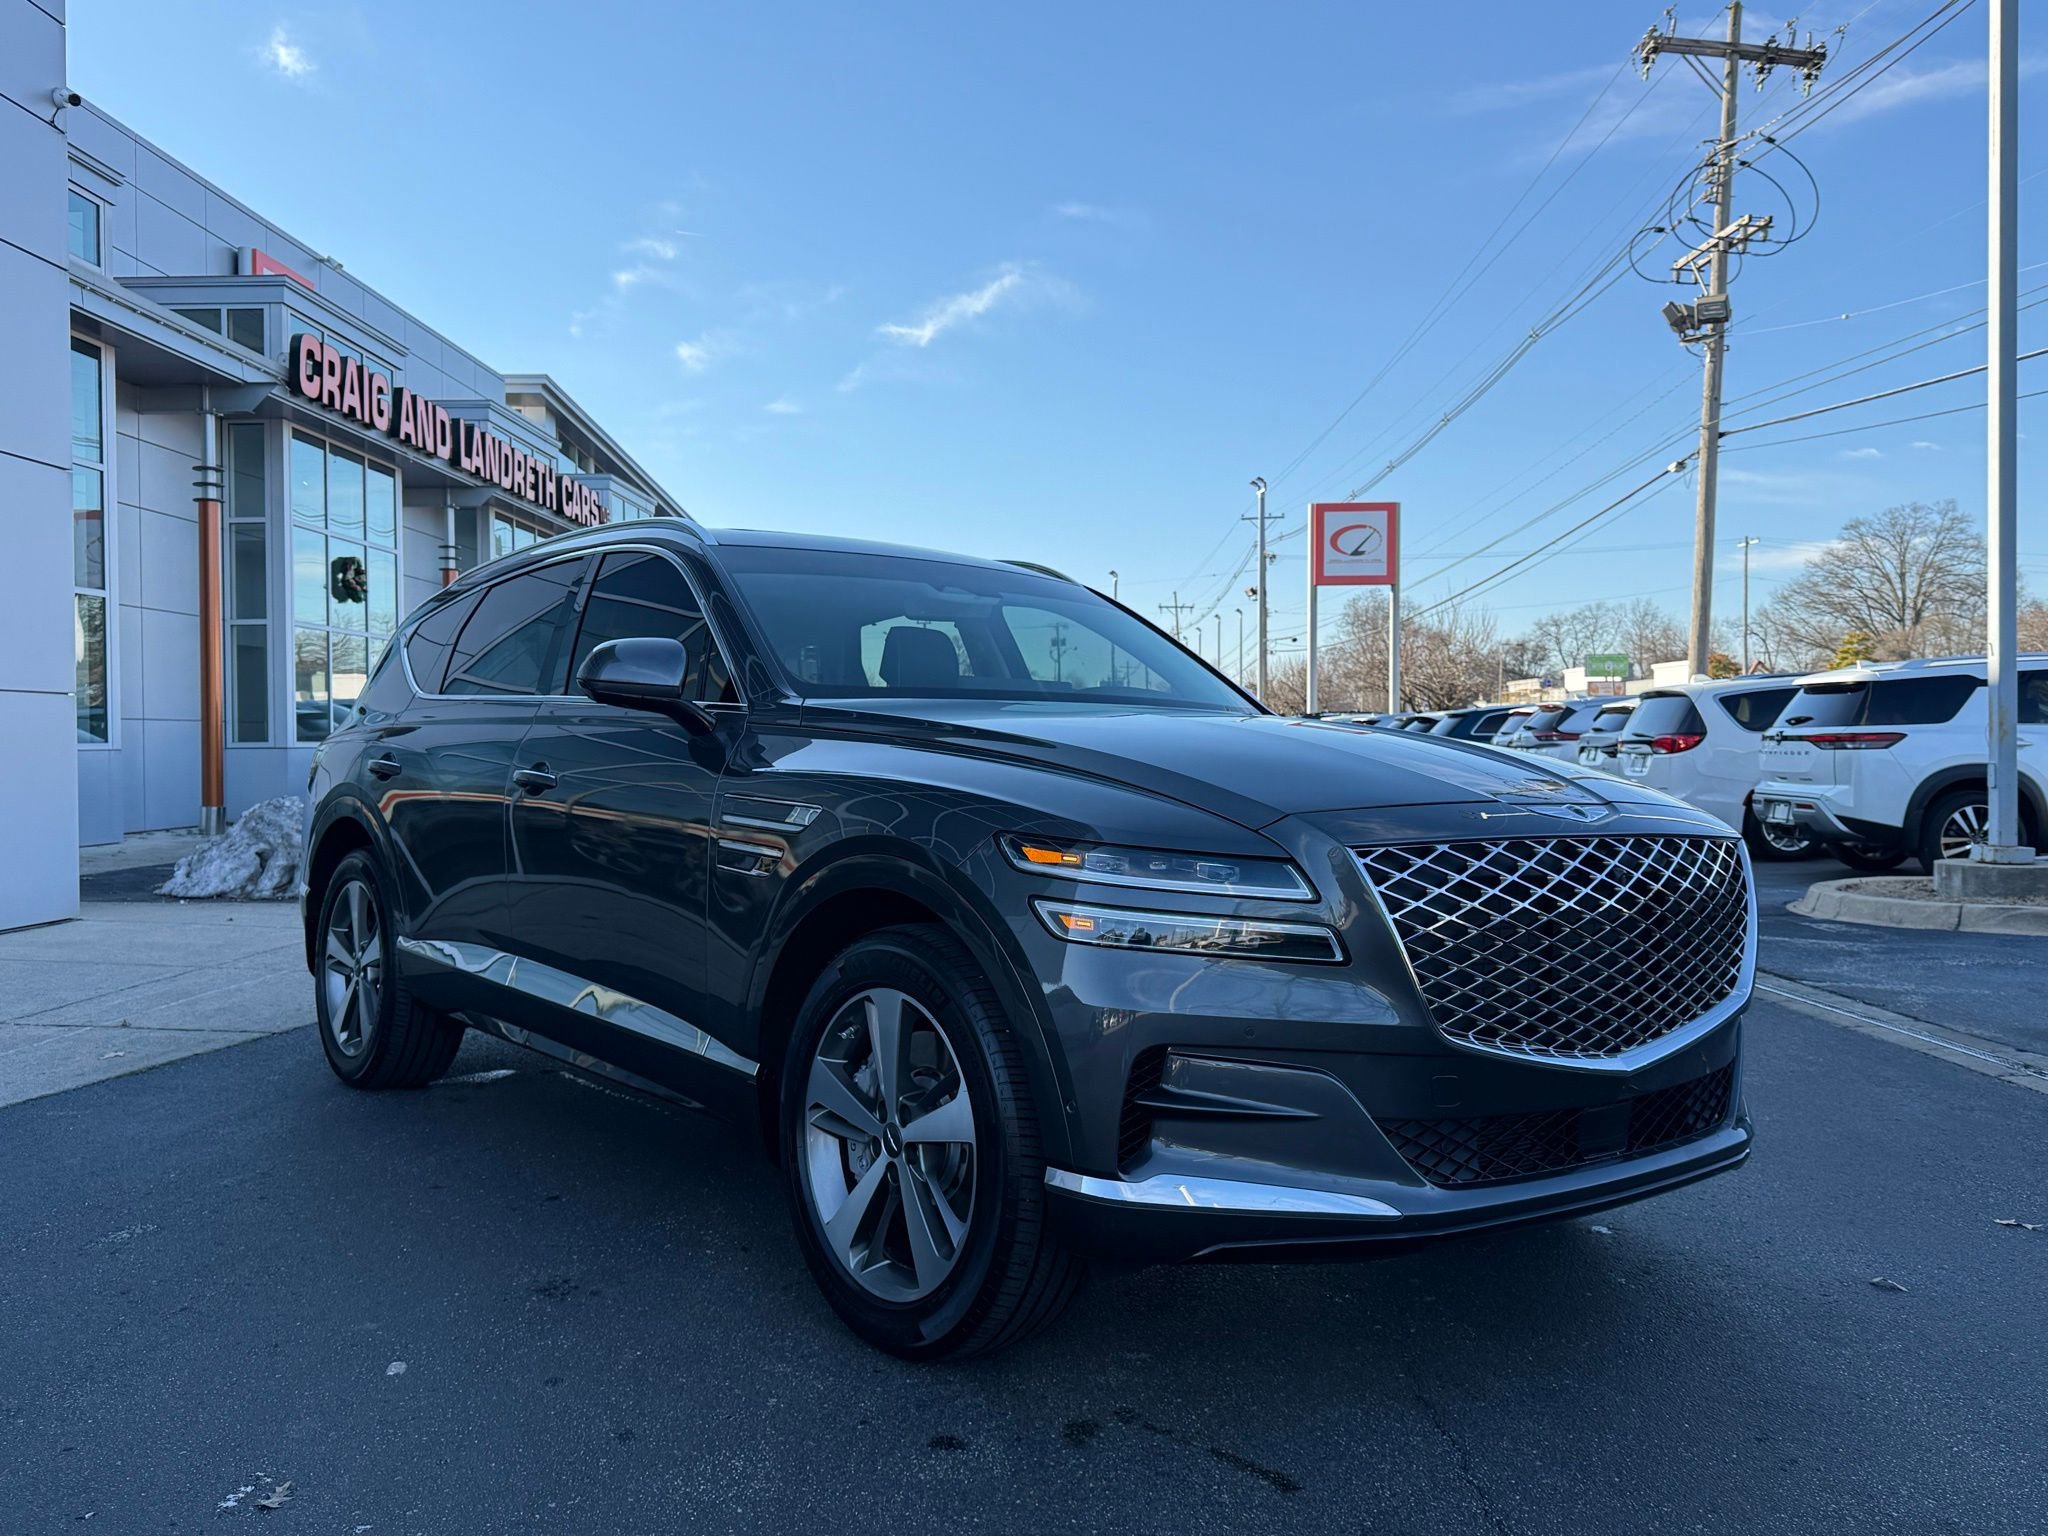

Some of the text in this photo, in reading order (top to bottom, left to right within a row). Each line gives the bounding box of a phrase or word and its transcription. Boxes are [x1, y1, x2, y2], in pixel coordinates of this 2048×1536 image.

[299, 333, 600, 527] CRAIG AND LANDRETH CARS
